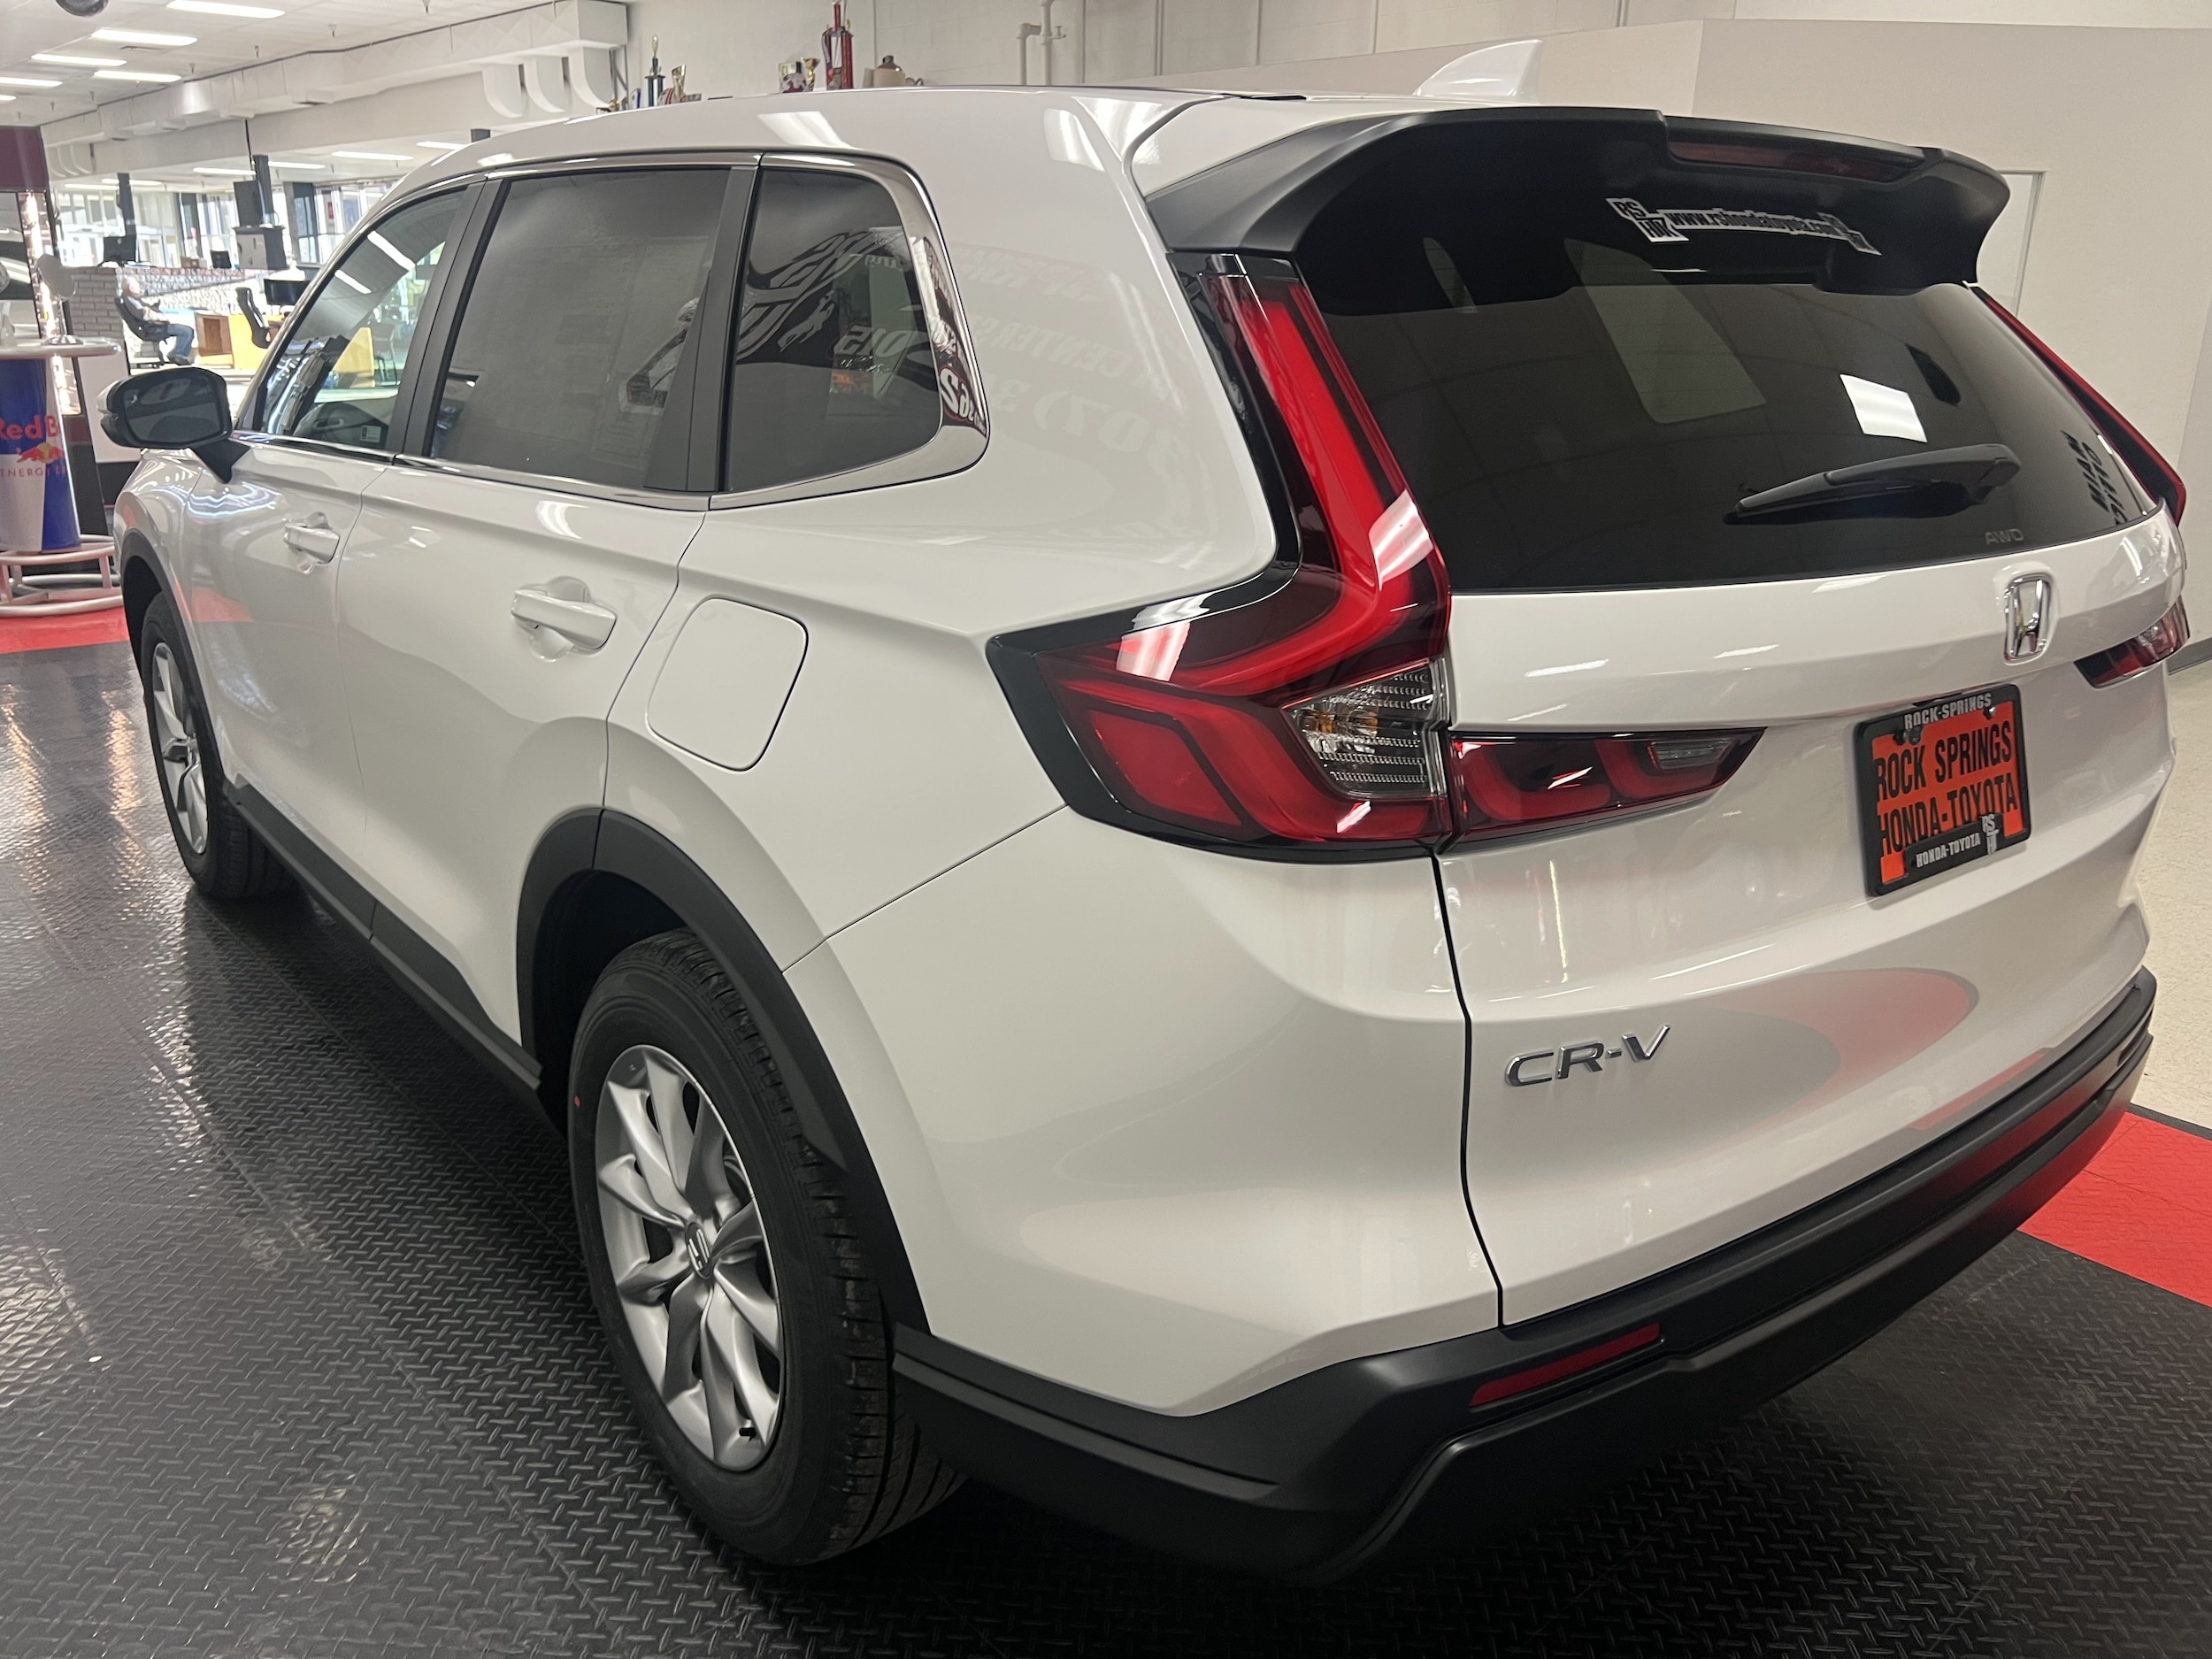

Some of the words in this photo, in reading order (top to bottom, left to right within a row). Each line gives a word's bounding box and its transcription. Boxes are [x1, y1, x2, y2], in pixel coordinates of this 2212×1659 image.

[1985, 529, 2024, 545] AWD
[1874, 745, 1926, 801] ROCK
[1935, 720, 2012, 783] SPRINGS
[1879, 772, 2018, 856] HONDA-TOYOTA
[1916, 833, 1981, 868] HONDA-TOYOTA
[1505, 1024, 1671, 1087] CR-V
